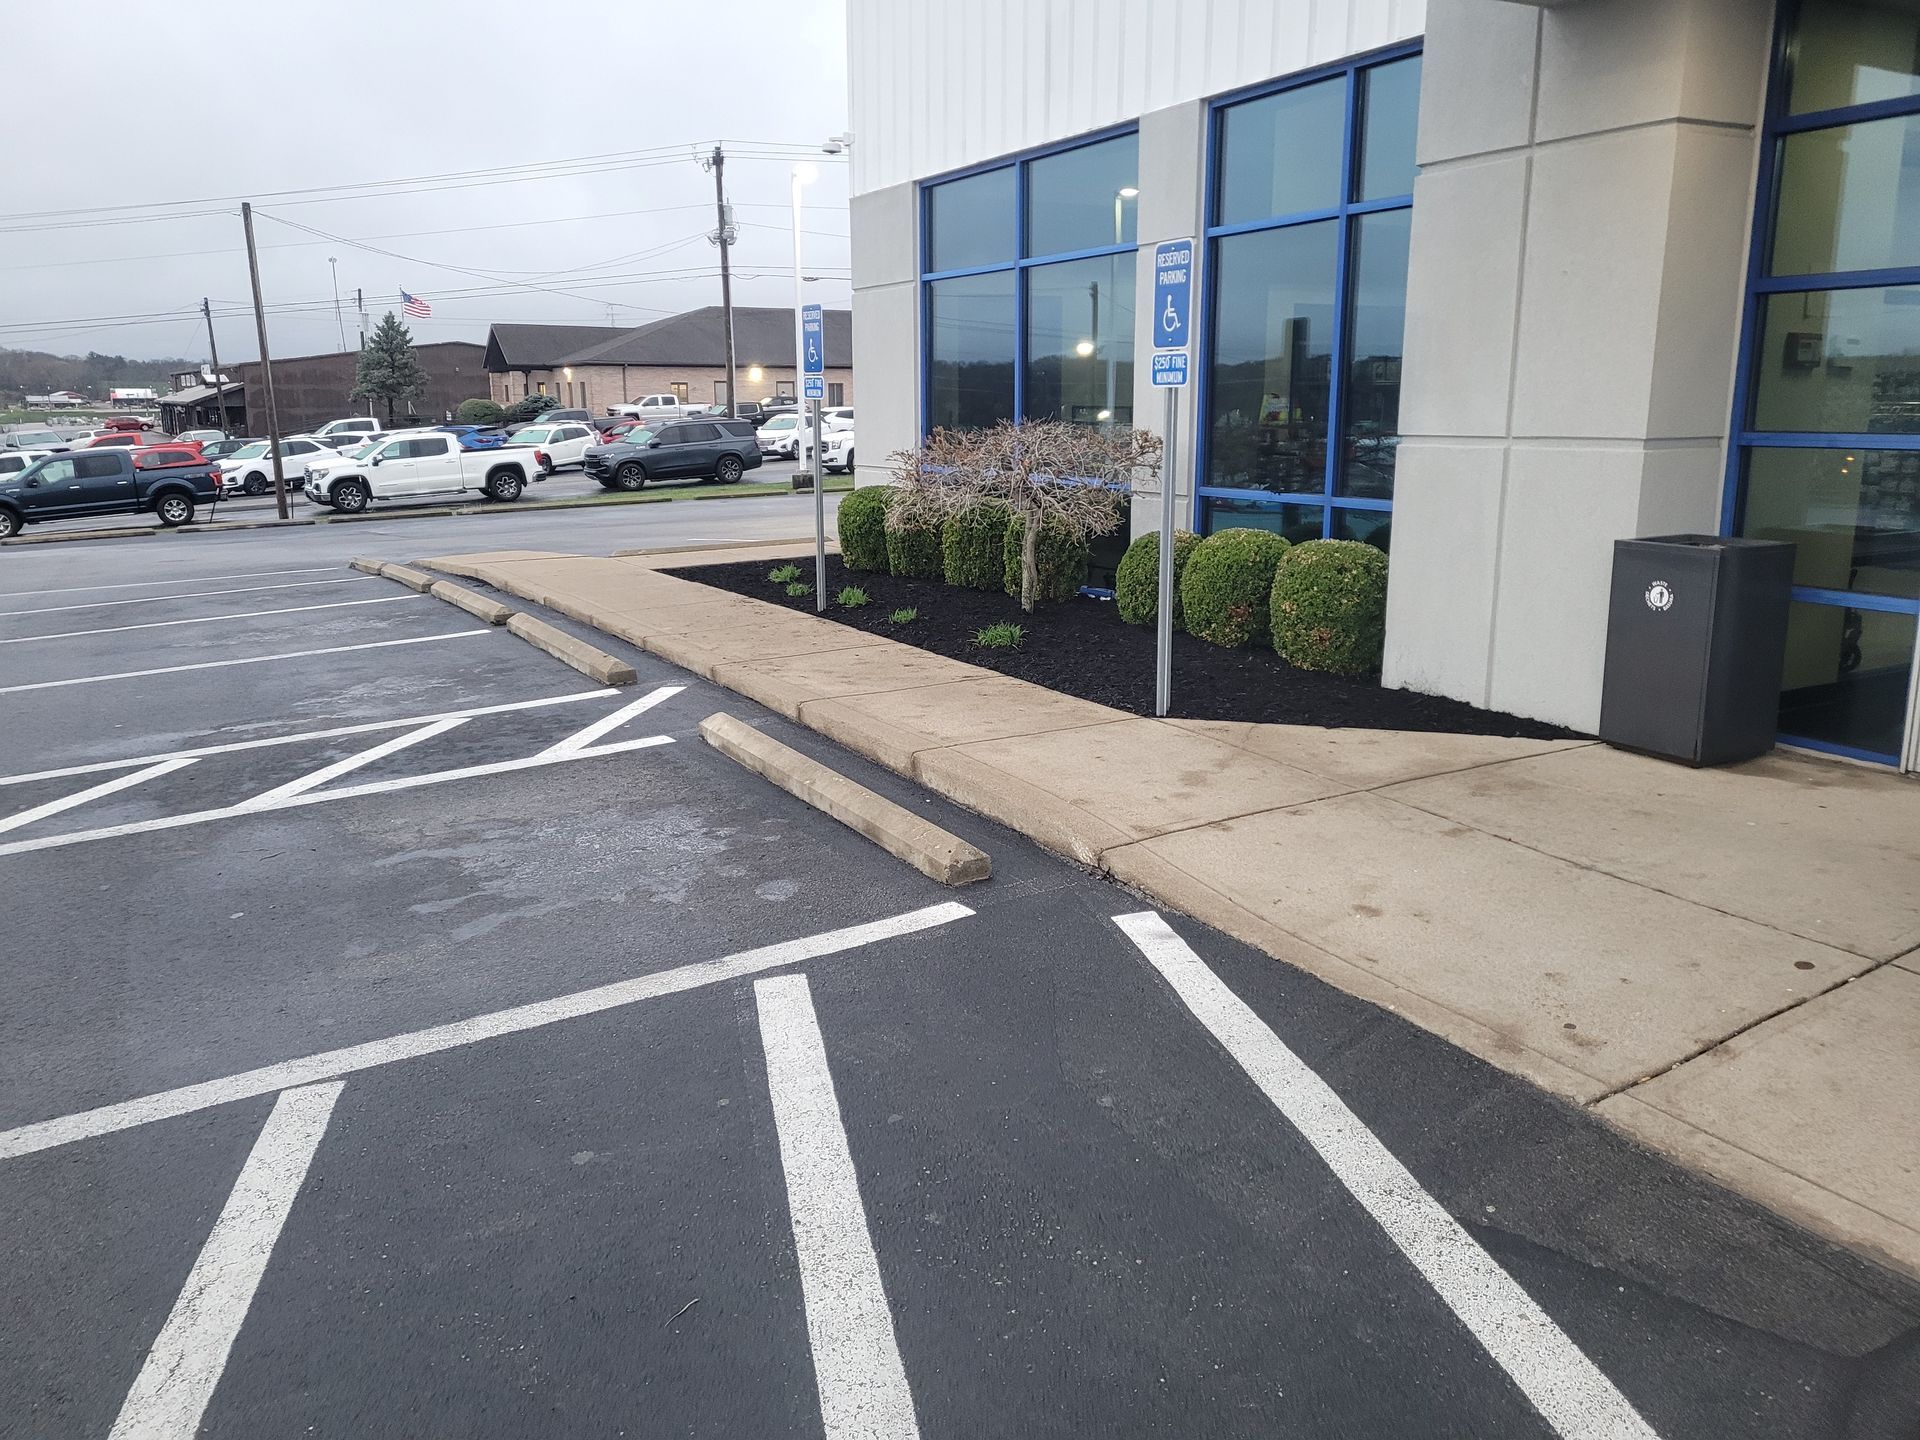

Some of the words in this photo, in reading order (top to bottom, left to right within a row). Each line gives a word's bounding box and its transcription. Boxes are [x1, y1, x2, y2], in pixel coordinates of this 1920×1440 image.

[1157, 250, 1190, 267] RESERVED
[1160, 269, 1187, 285] PARKING
[1154, 355, 1171, 370] $250
[1172, 355, 1186, 369] FINE
[1156, 370, 1183, 384] MINIMUM
